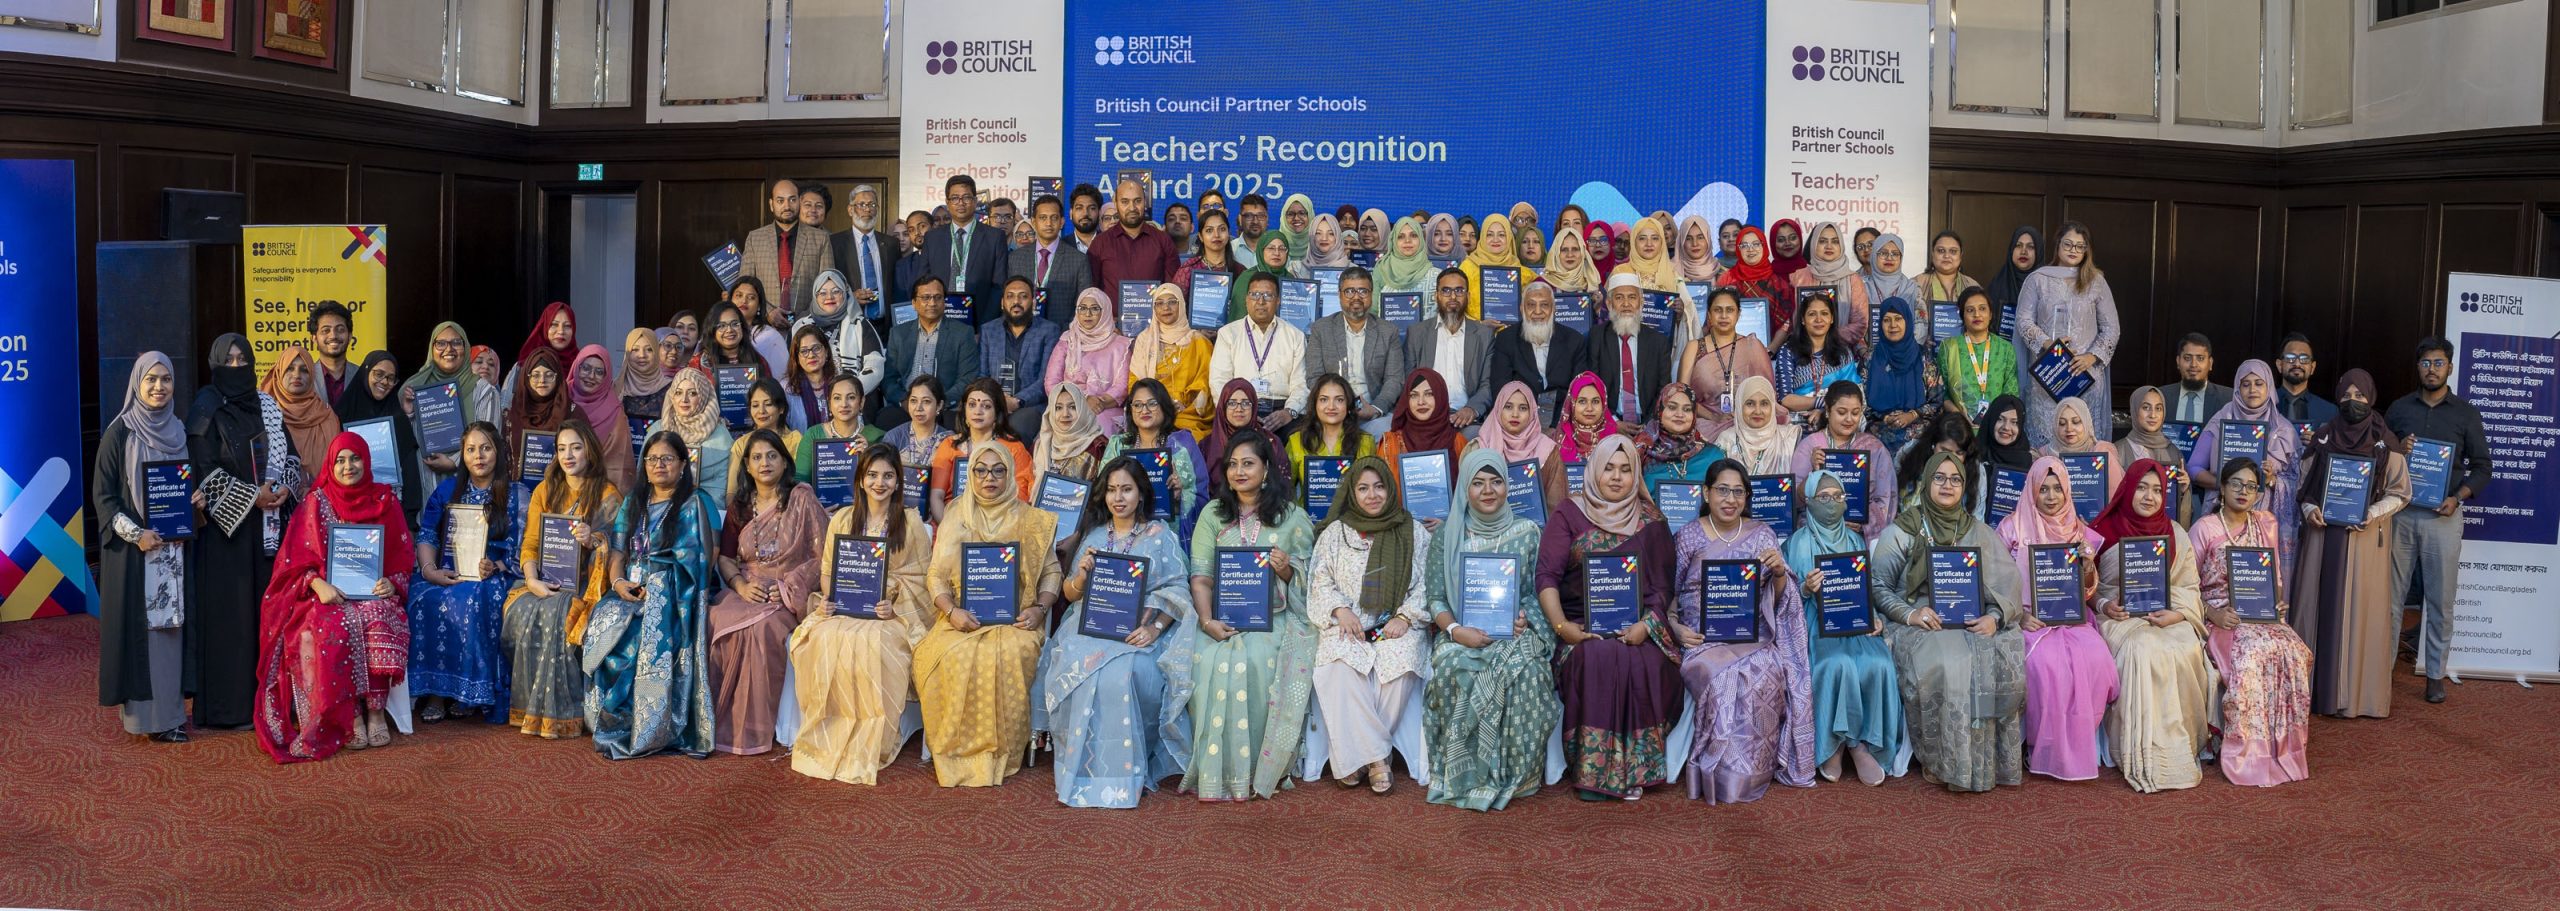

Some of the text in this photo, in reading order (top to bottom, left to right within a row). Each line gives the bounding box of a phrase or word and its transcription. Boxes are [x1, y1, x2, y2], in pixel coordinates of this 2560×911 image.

[963, 40, 1032, 56] BRITISH
[1128, 35, 1192, 50] BRITISH
[1128, 50, 1196, 65] COUNCIL
[1830, 48, 1900, 66] BRITISH
[961, 56, 1036, 74] COUNCIL
[1830, 65, 1904, 84] COUNCIL
[1095, 97, 1366, 112] British Council Partner Schools
[926, 118, 1016, 130] British Council
[926, 131, 1027, 144] Partner Schools
[1792, 126, 1884, 140] British Council
[1095, 135, 1446, 169] Teachers’ Recognition
[1792, 140, 1894, 155] Partner Schools
[1098, 173, 1283, 200] Ard 2025
[1792, 172, 1879, 190] Teachers’
[926, 185, 1029, 200] Reition
[1792, 195, 1899, 216] Recognition
[2481, 294, 2523, 305] BRITISH
[254, 298, 366, 316] See, he or
[2481, 304, 2524, 316] COUNCIL
[254, 317, 311, 336] experi
[420, 403, 447, 411] Certificate
[421, 407, 454, 418] appreciation
[2410, 463, 2442, 472] appreciation
[2412, 457, 2437, 465] Certificate
[149, 491, 185, 499] appreciation
[838, 566, 876, 574] appreciation
[839, 559, 870, 567] Certificate
[1094, 576, 1126, 586] Certificate
[1823, 583, 1860, 592] appreciation
[1092, 584, 1133, 594] appreciation
[2457, 584, 2536, 594] ritishCouncilBangladesh
